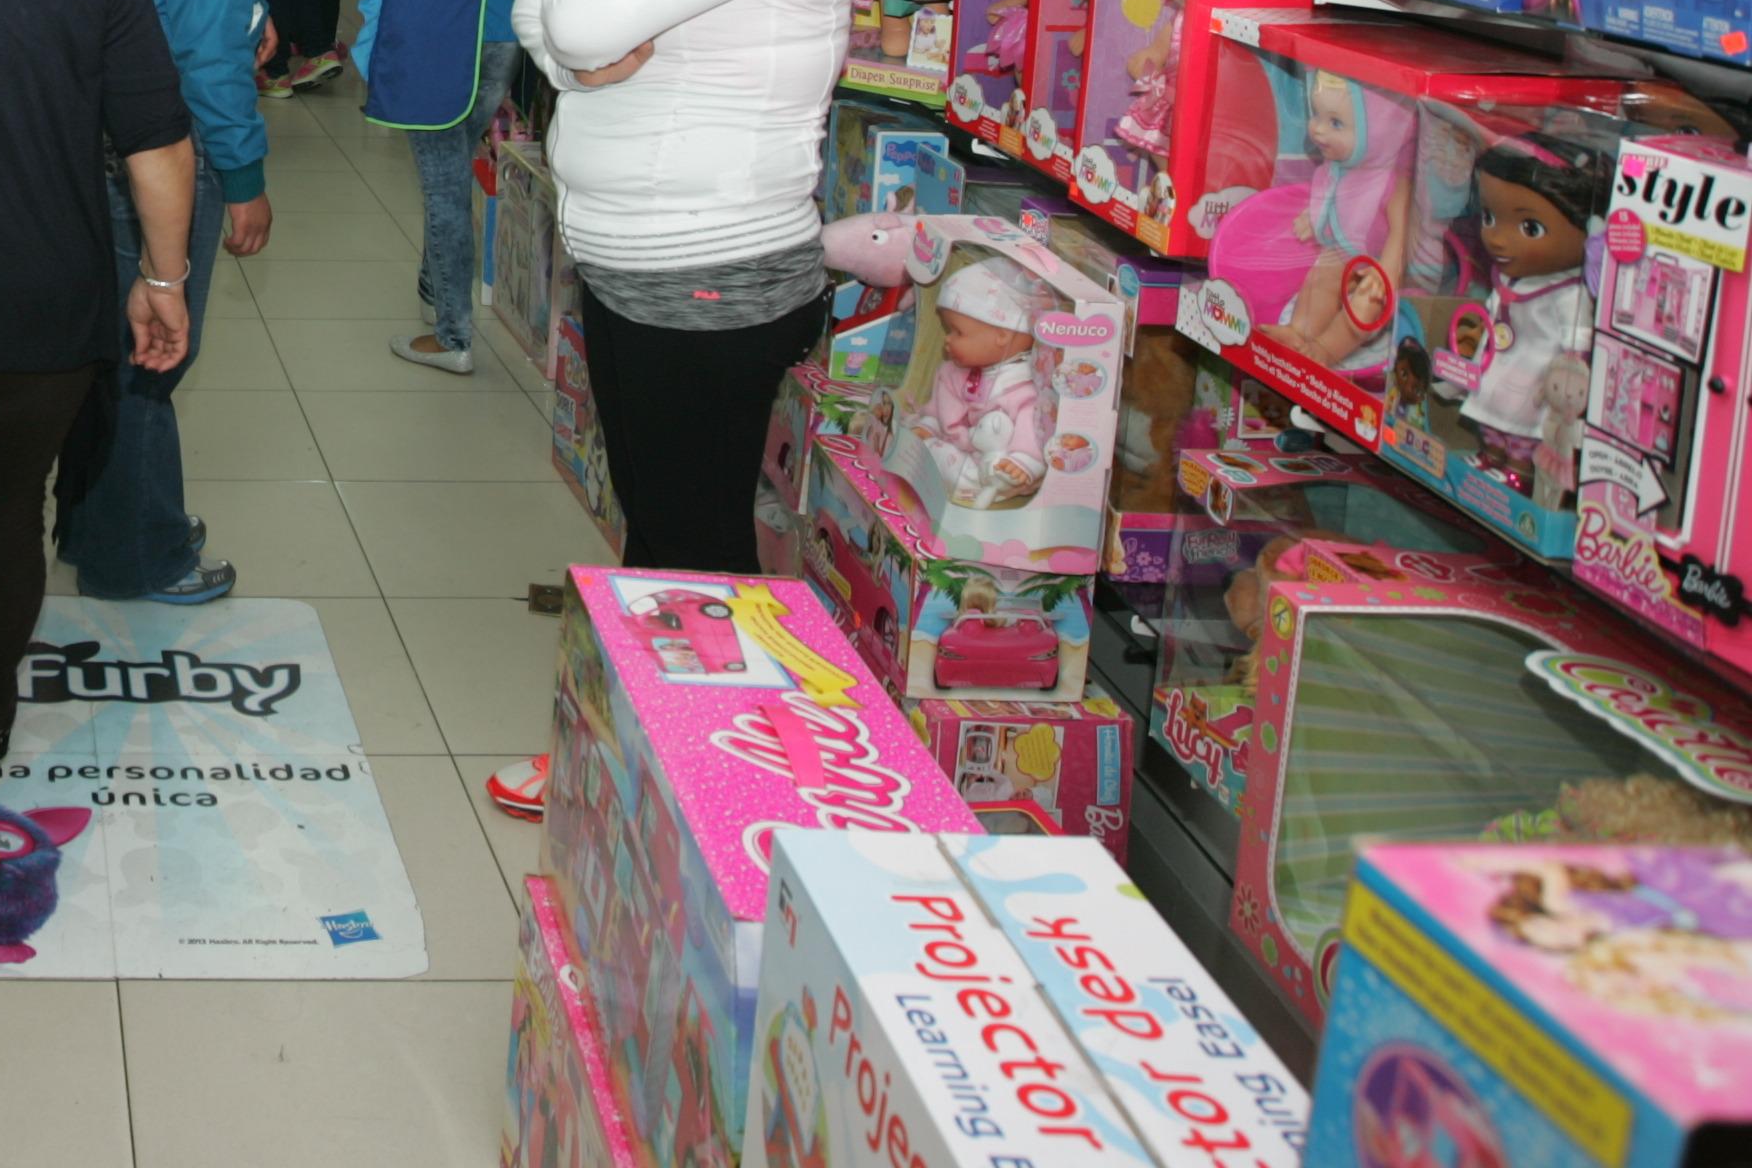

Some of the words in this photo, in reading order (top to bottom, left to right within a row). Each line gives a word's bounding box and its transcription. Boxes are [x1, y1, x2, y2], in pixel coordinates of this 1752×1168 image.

[1079, 168, 1115, 194] MOMMY
[1204, 200, 1230, 216] littl
[1616, 168, 1746, 232] style
[1205, 287, 1227, 308] little
[1040, 320, 1109, 339] Nenuco
[1204, 302, 1246, 332] MOMMY
[1575, 506, 1666, 600] Barbie
[1682, 565, 1731, 609] Barbie
[48, 761, 351, 783] personalidad
[91, 786, 218, 808] única
[278, 938, 319, 946] Reserved.
[889, 892, 1103, 1151] Projector
[829, 984, 930, 1168] Proje
[895, 992, 1004, 1146] Learning
